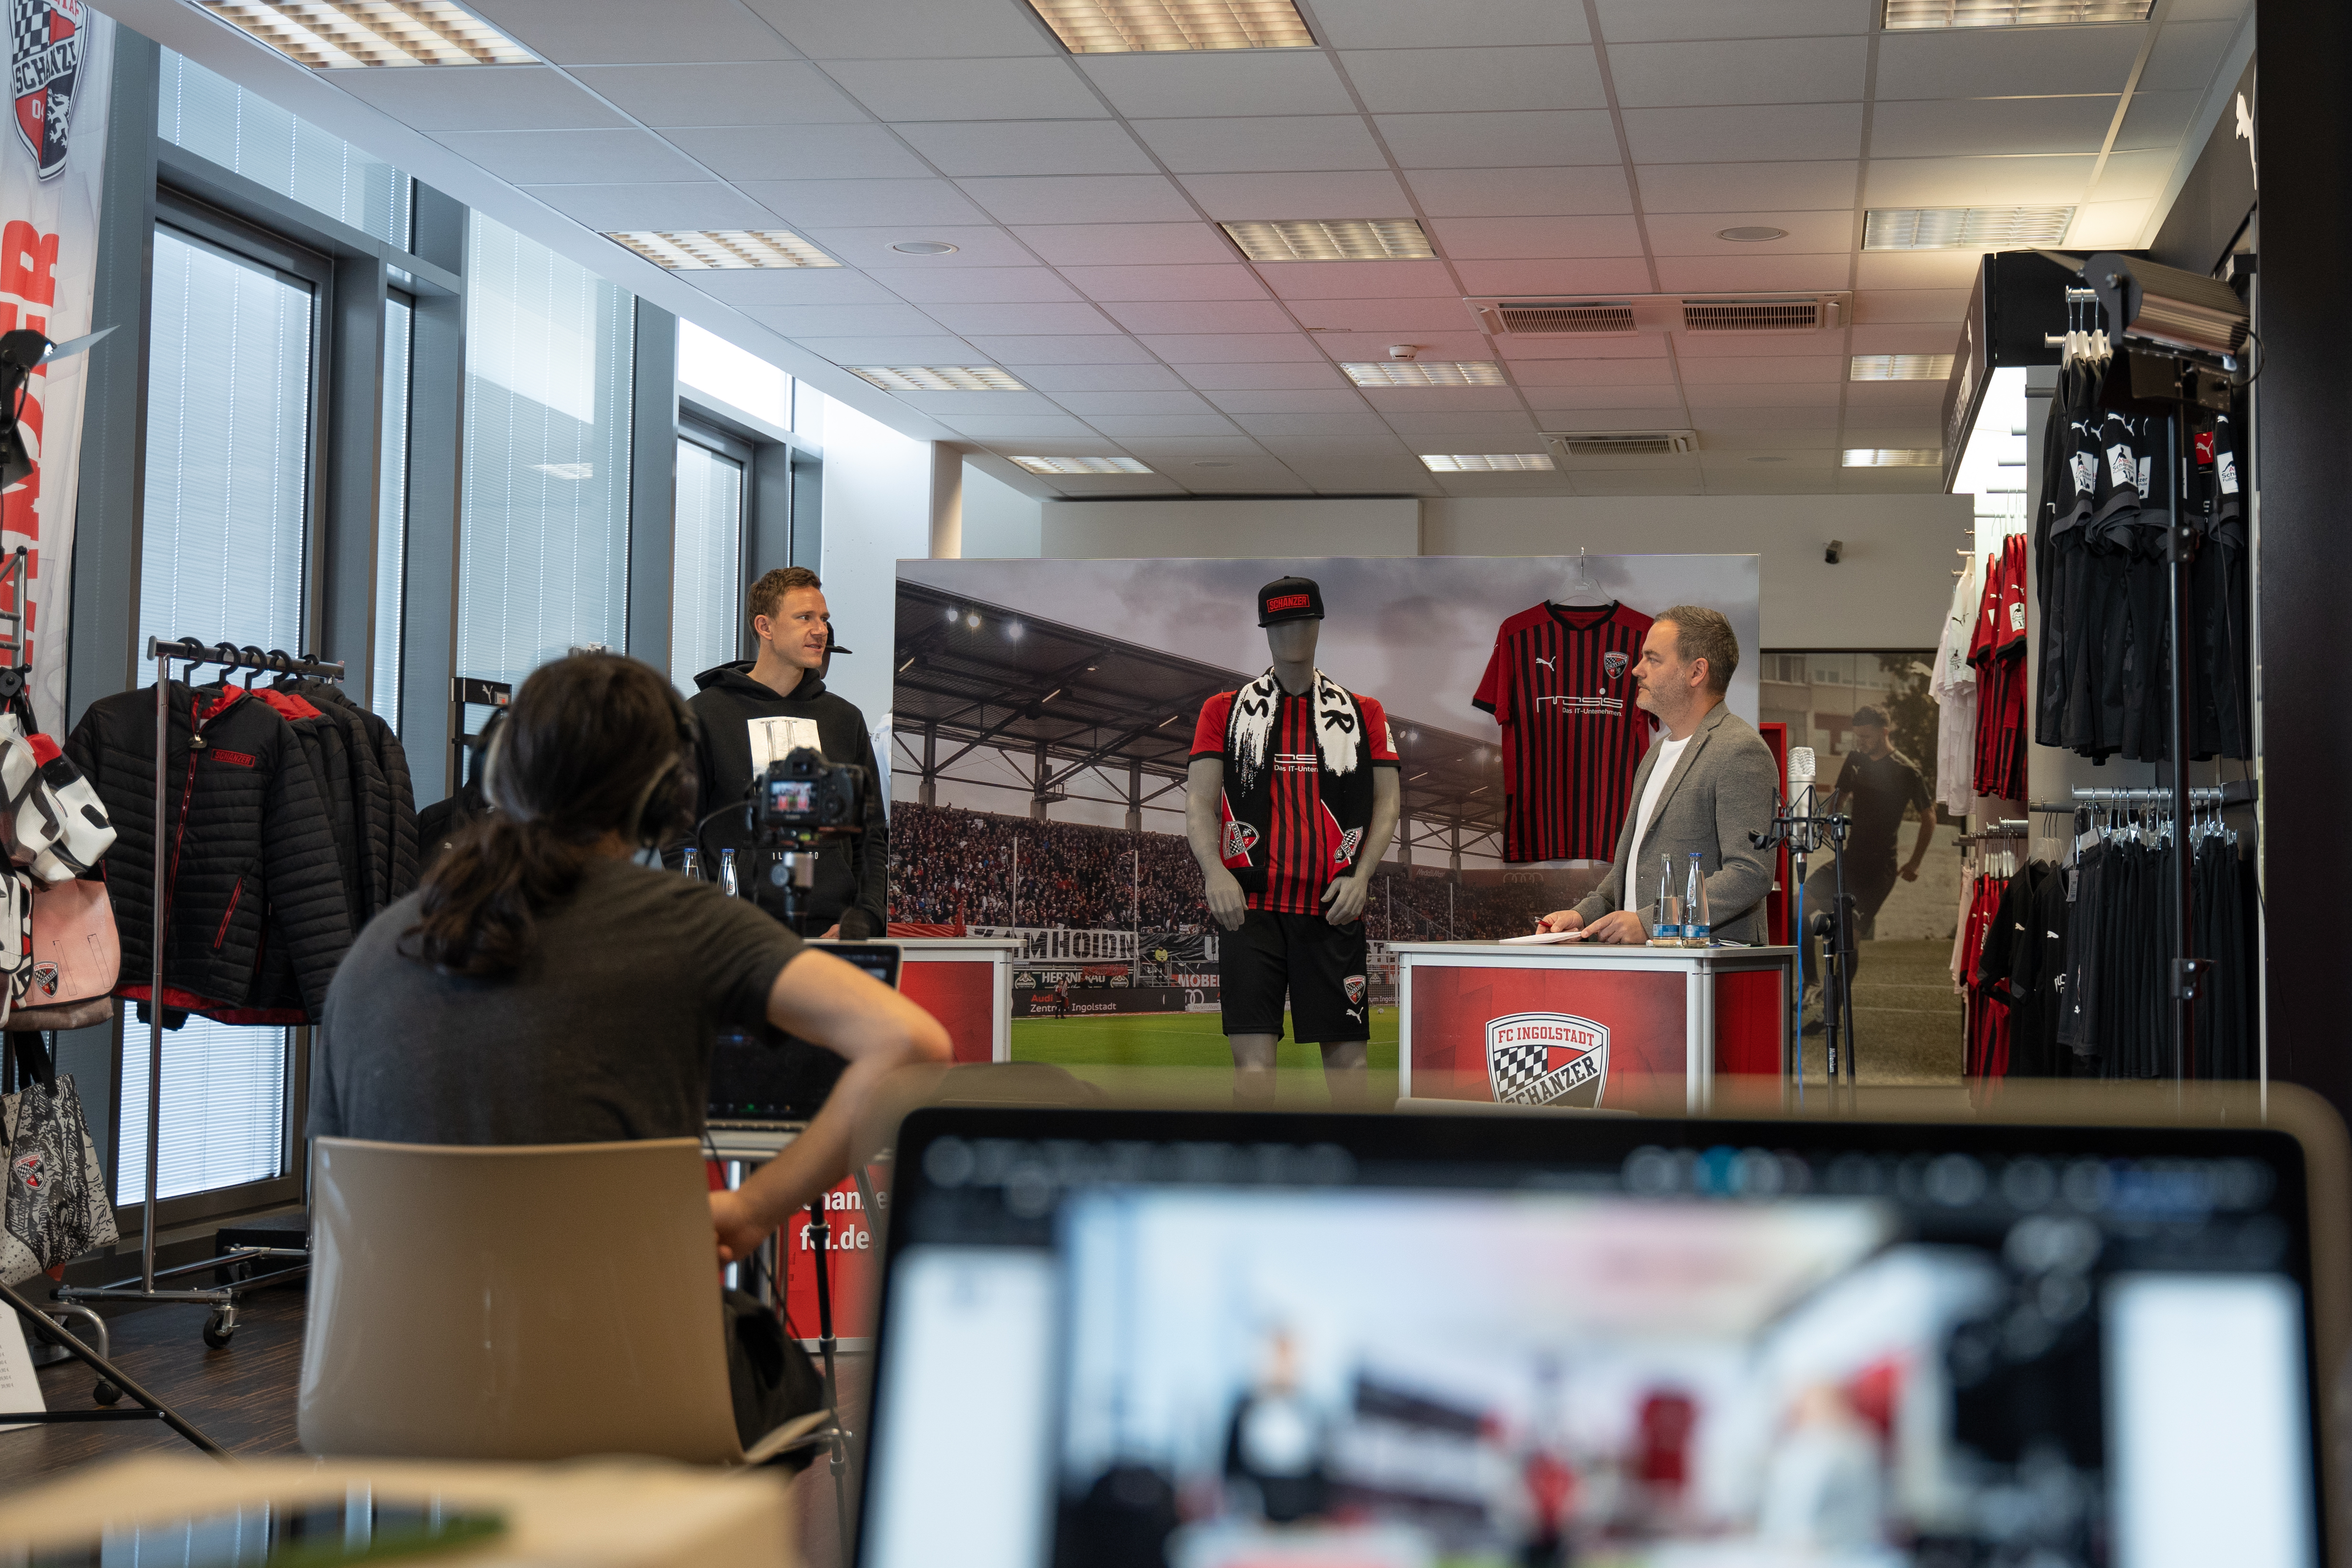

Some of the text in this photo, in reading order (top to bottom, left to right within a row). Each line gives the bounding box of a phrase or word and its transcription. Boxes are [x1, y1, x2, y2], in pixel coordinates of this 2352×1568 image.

[1269, 596, 1307, 610] SCHANZER
[39, 969, 56, 987] SCHANZER
[1031, 994, 1053, 1002] Audi
[1072, 1002, 1117, 1012] Ingolstadt
[1498, 1027, 1594, 1046] FC INGOLSTADT
